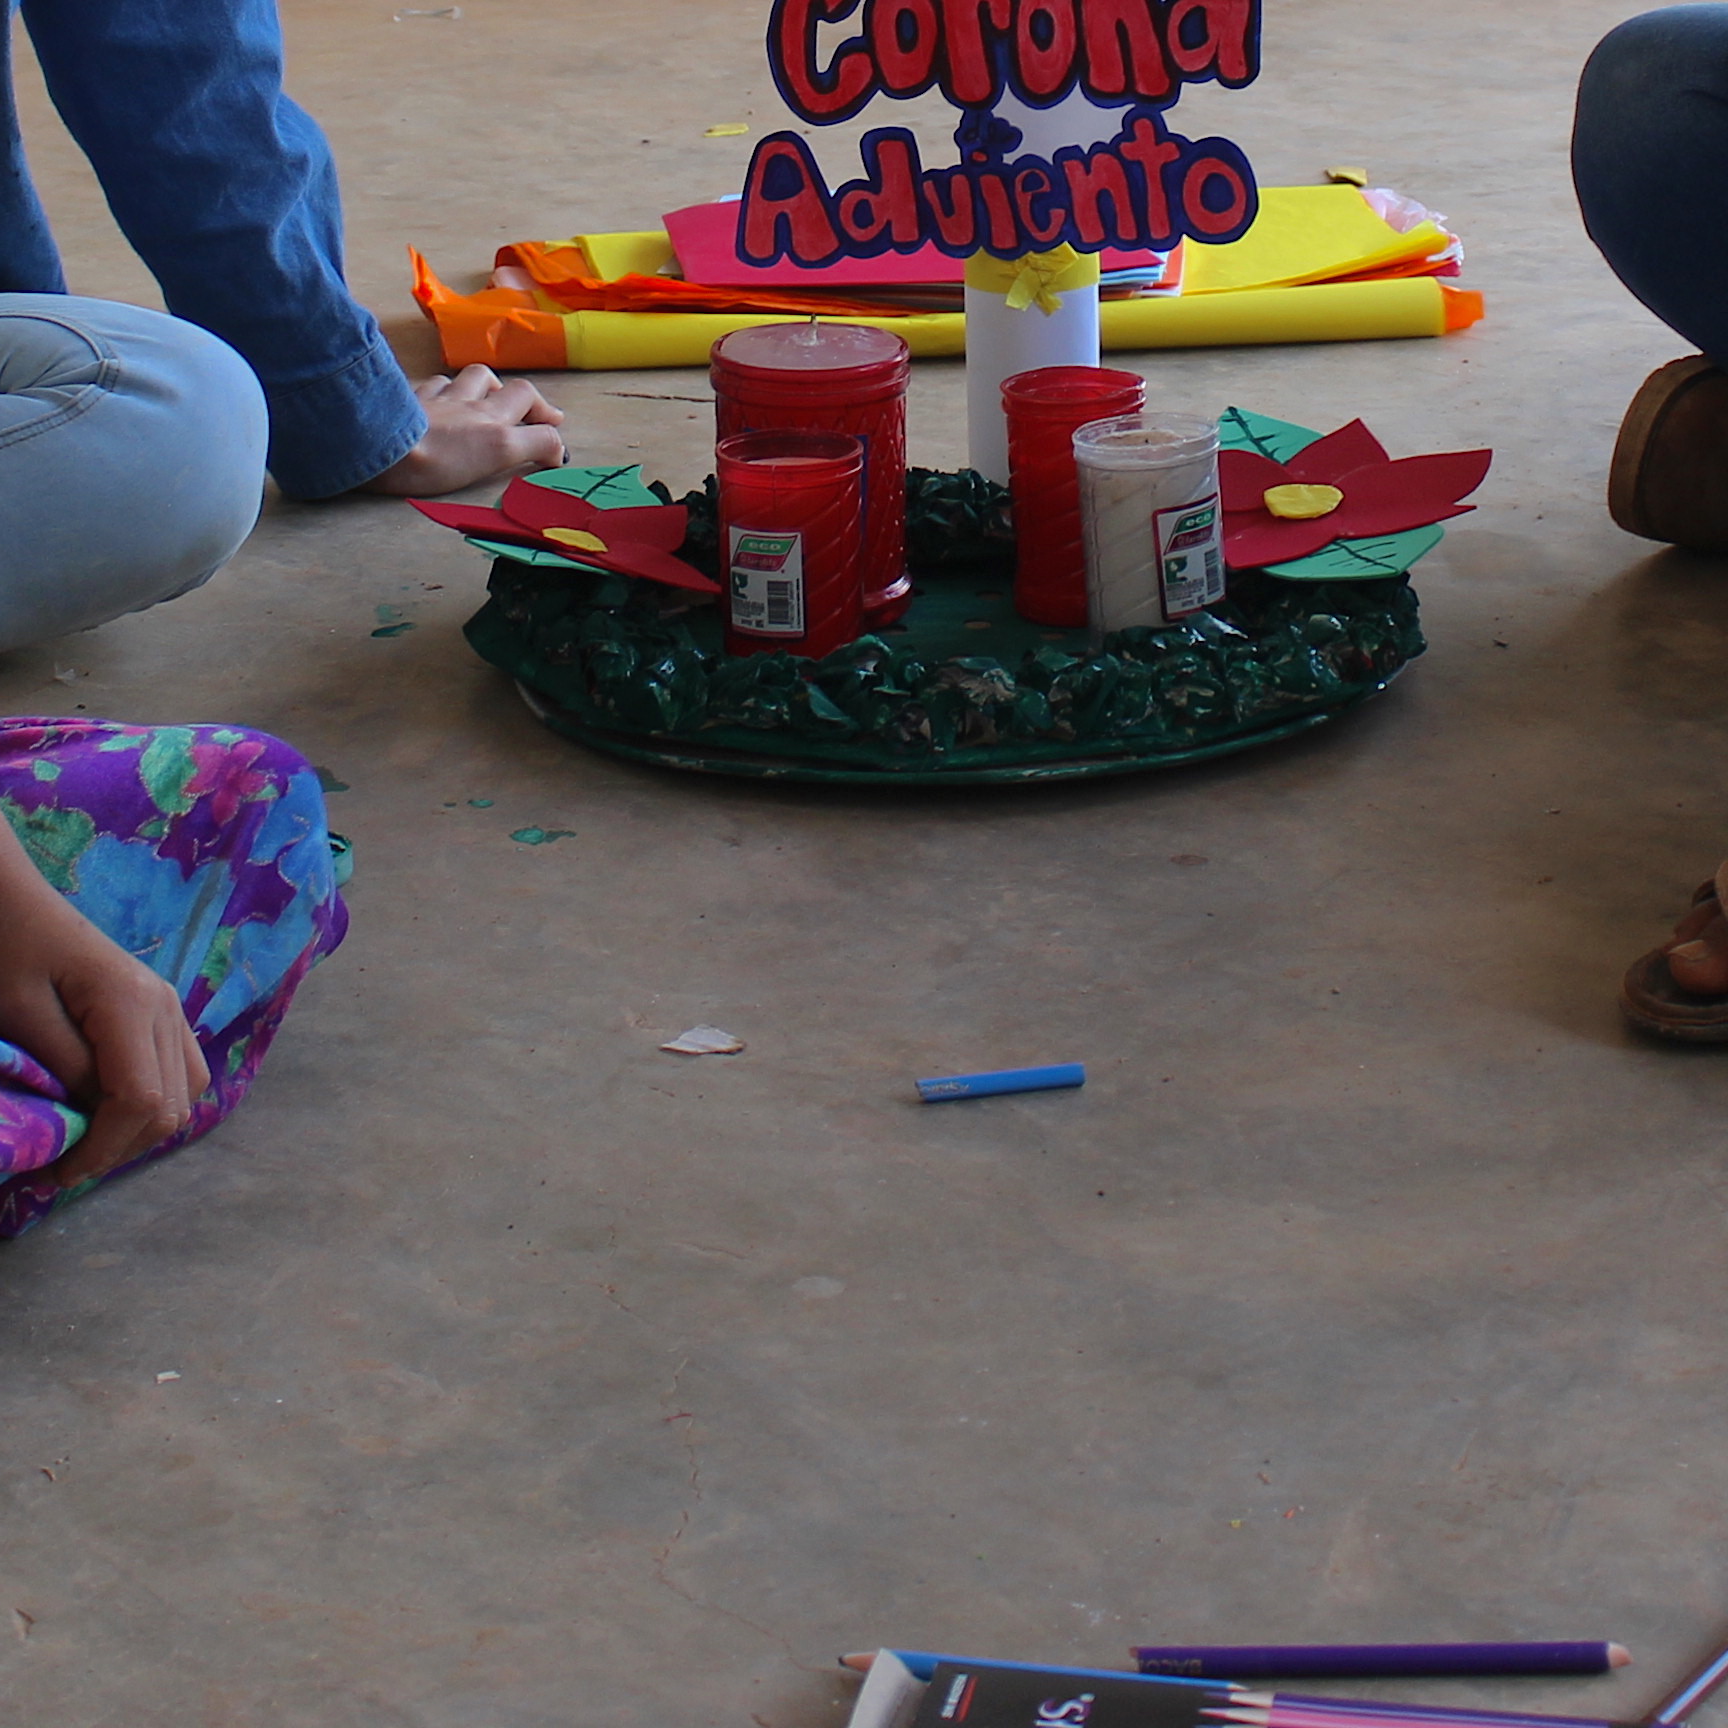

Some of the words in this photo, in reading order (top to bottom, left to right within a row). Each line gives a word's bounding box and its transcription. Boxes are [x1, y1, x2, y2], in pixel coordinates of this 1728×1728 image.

[739, 113, 1255, 266] Adviento
[1184, 512, 1212, 527] eco
[748, 541, 781, 552] eco
